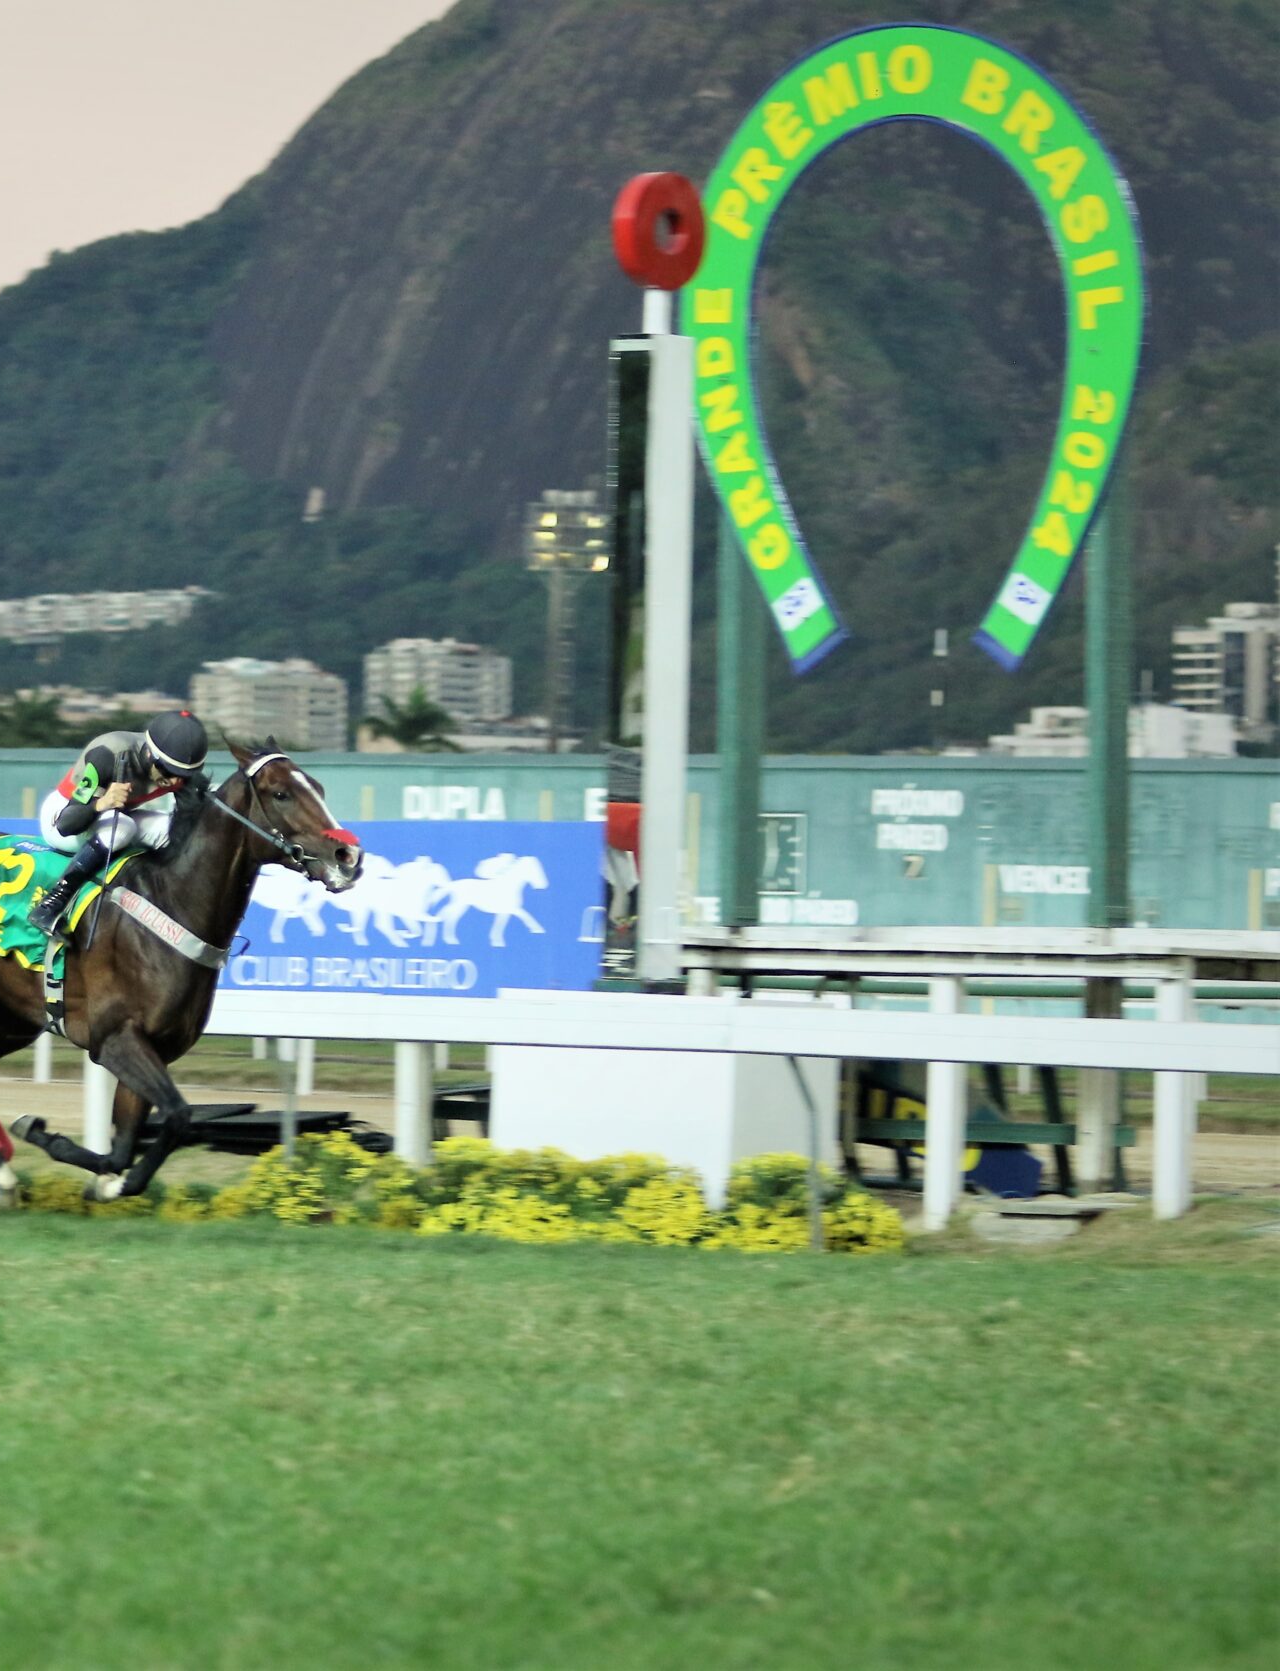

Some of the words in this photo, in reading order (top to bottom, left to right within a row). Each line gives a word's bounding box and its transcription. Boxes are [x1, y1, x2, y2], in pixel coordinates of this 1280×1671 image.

[711, 45, 932, 239] PRÊMIO
[962, 58, 1124, 329] BRASIL
[694, 288, 790, 570] GRANDE
[1032, 384, 1115, 556] 2024
[403, 785, 506, 820] DUPLA
[230, 955, 309, 986] CLUB
